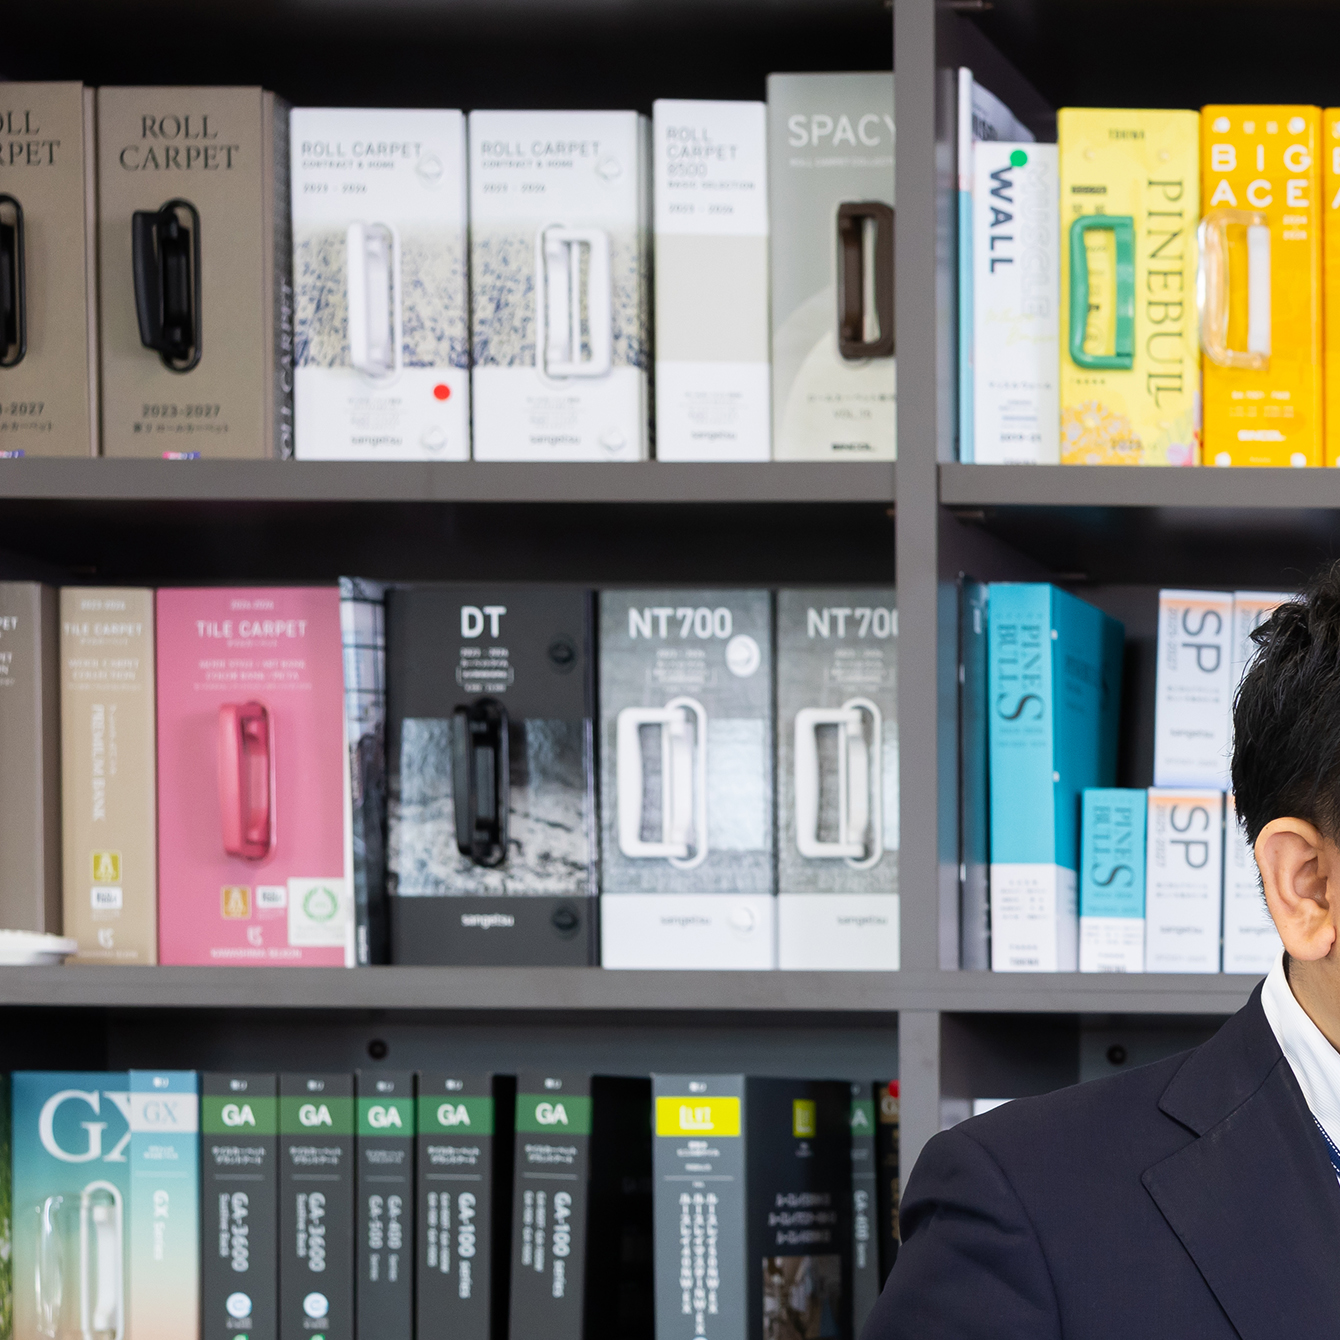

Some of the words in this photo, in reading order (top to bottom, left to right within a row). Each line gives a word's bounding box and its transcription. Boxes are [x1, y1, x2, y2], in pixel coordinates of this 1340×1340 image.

[141, 115, 218, 140] ROLL
[667, 127, 710, 143] ROLL
[120, 145, 239, 171] CARPET
[302, 142, 346, 158] ROLL
[352, 142, 423, 158] CARPET
[481, 142, 525, 158] ROLL
[531, 142, 600, 158] CARPET
[667, 145, 738, 160] CARPET
[1211, 145, 1311, 171] BIG
[1210, 180, 1310, 207] ACE
[990, 165, 1015, 274] WALL
[65, 624, 94, 637] TILE
[98, 623, 143, 637] CARPET
[196, 620, 233, 638] TILE
[239, 619, 307, 638] CARPET
[460, 606, 507, 638] DT
[628, 607, 733, 639] NT700
[1181, 606, 1222, 674] SP
[1169, 805, 1210, 869] SP
[142, 1100, 179, 1124] GX
[221, 1104, 256, 1127] GA
[299, 1104, 333, 1127] GA
[367, 1105, 402, 1129] GA
[436, 1104, 471, 1127] GA
[535, 1103, 569, 1126] GA
[230, 1191, 249, 1273] GA-3600
[308, 1191, 326, 1273] GA-3600
[457, 1191, 476, 1258] GA-100
[552, 1191, 572, 1258] GA-100
